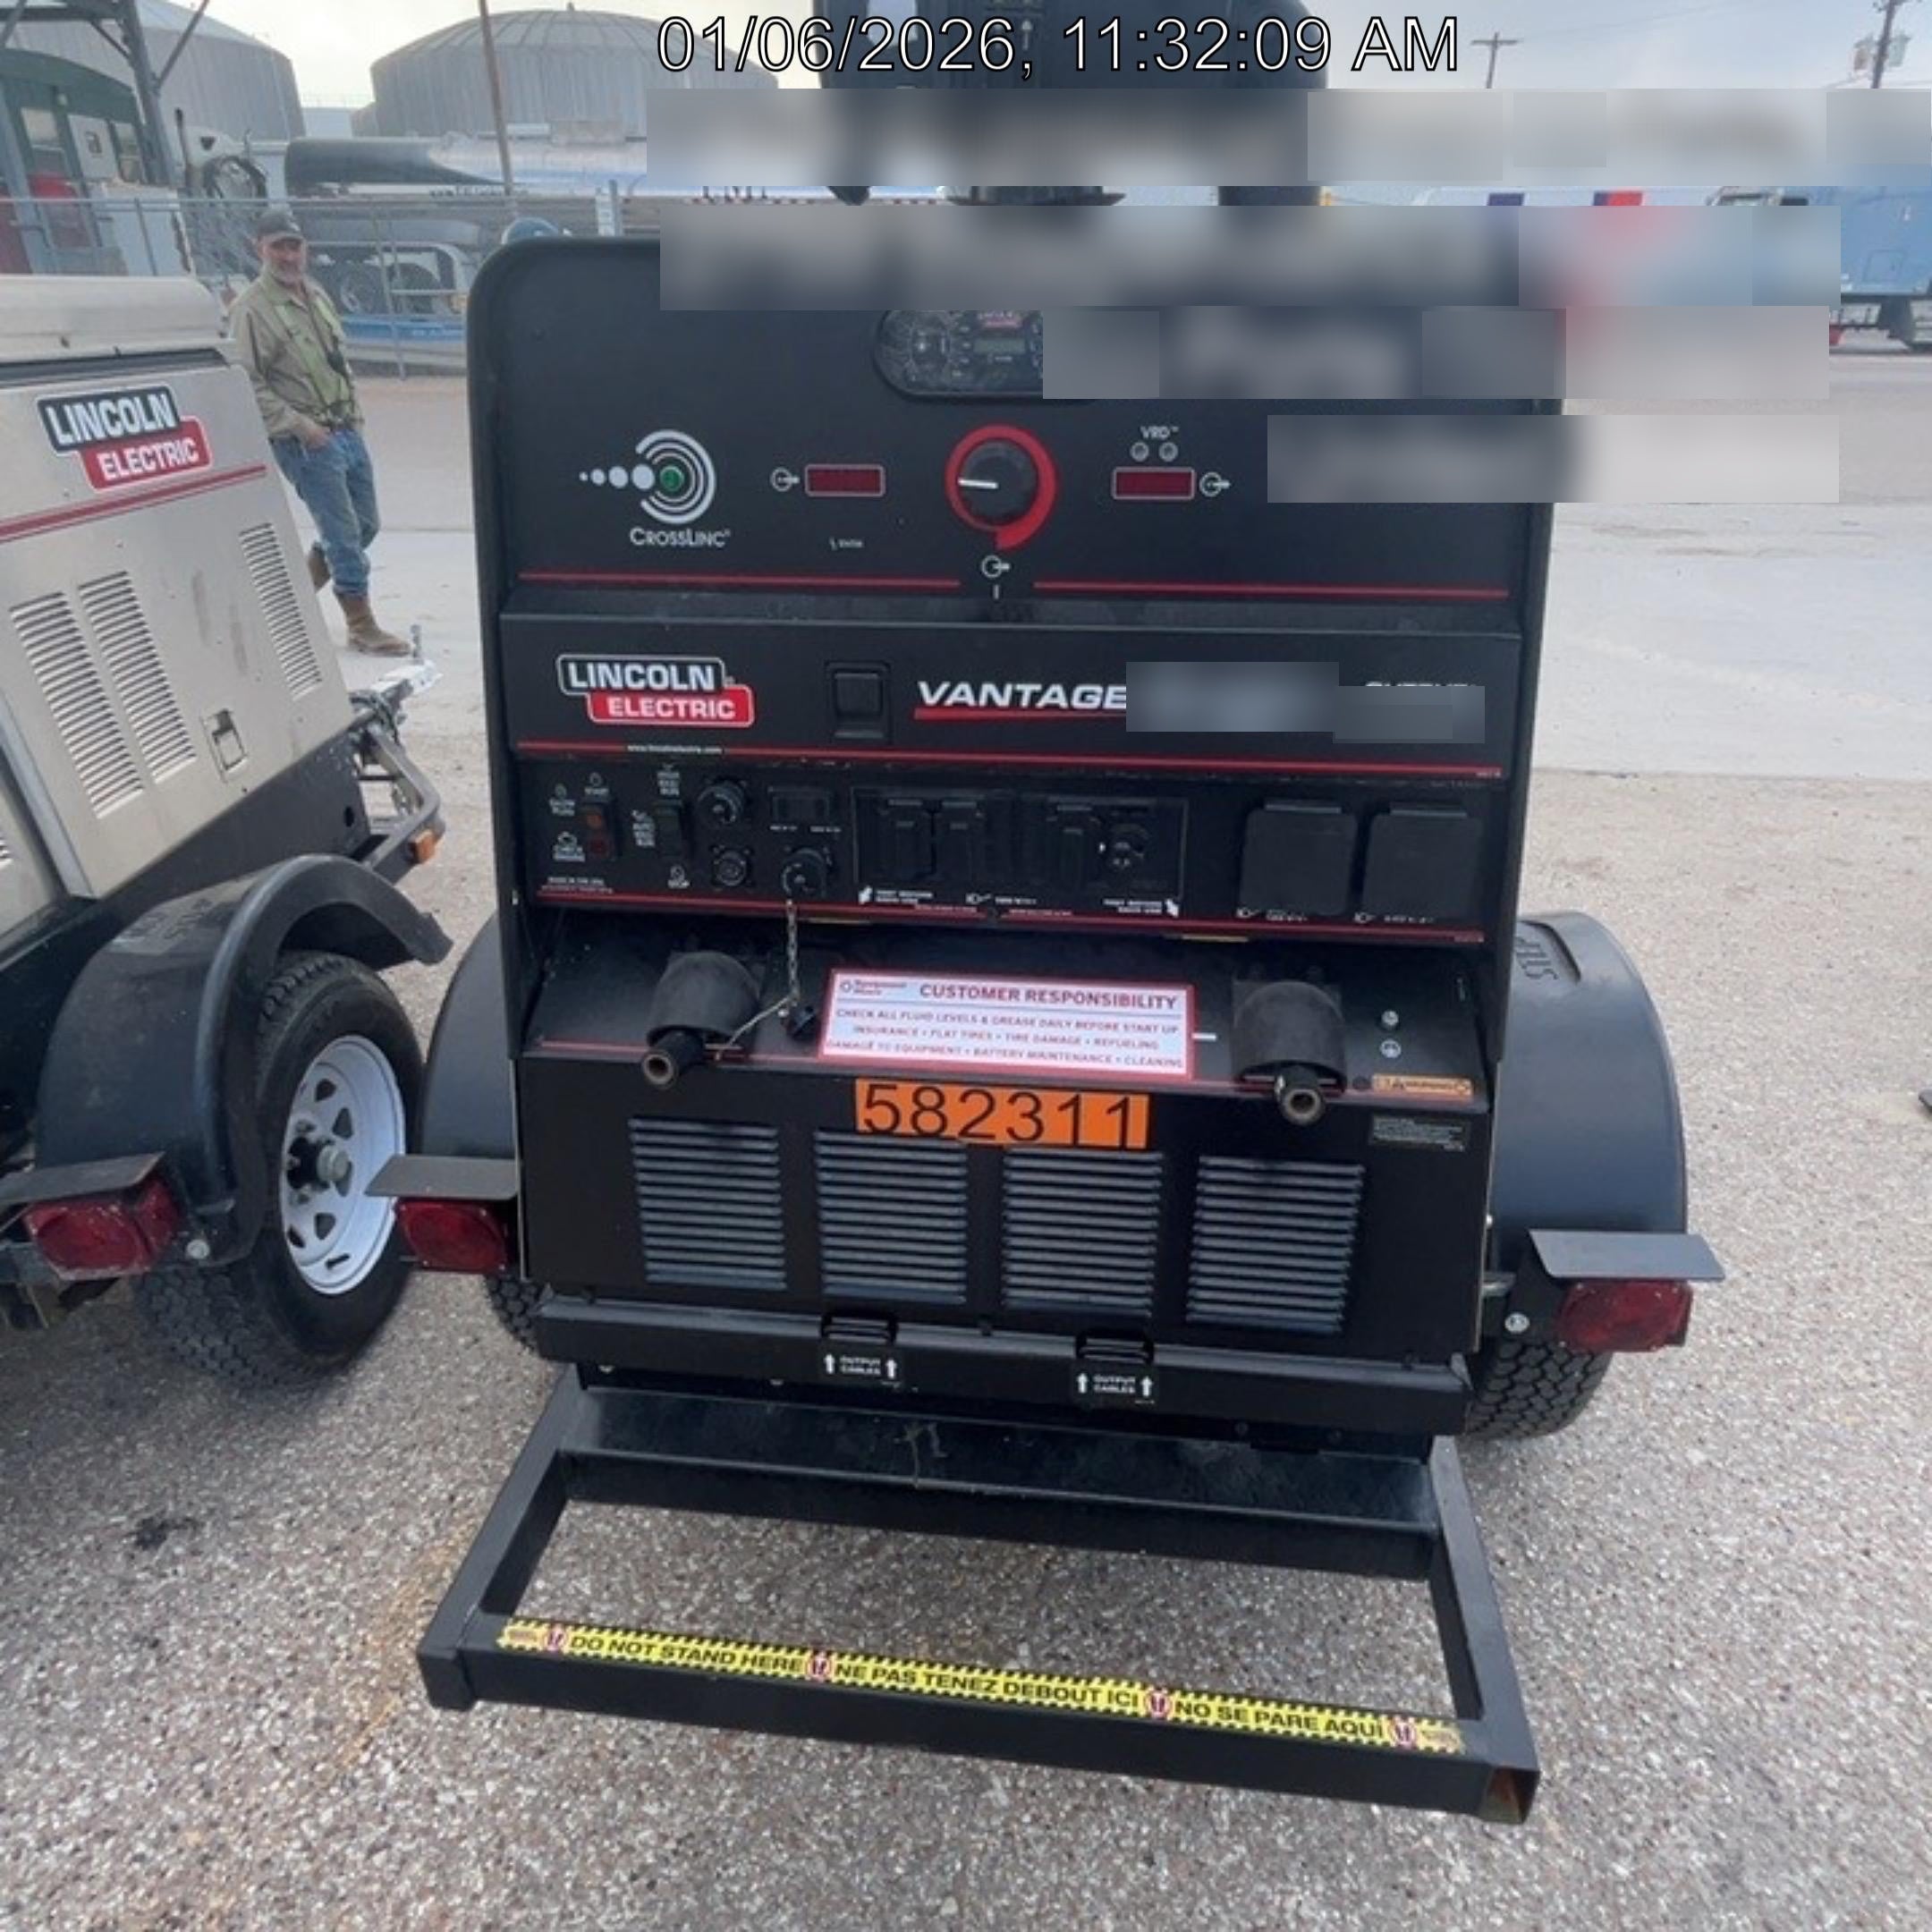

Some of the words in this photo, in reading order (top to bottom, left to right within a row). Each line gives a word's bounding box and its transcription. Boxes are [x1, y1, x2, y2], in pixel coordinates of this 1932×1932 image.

[46, 394, 177, 445] LINCOLN
[97, 437, 199, 481] ELECTRIC
[567, 662, 715, 691] LINCOLN
[606, 696, 736, 719] ELECTRIC
[918, 681, 1126, 710] VANTAGE
[920, 984, 1021, 1002] CUSTOMER
[1025, 989, 1177, 1009] RESPONSIBILITY
[837, 1009, 874, 1019] CHECK
[877, 1011, 897, 1020] ALL
[901, 1012, 934, 1021] FLUID
[936, 1013, 977, 1023] LEVELS
[992, 1016, 1036, 1027] GREASE
[1038, 1018, 1071, 1028] DAILY
[1075, 1021, 1118, 1031] BEFORE
[1123, 1023, 1159, 1033] START
[1163, 1025, 1178, 1034] UP
[854, 1026, 919, 1037] INSURANCE
[931, 1029, 956, 1038] FLAT
[1005, 1033, 1029, 1042] TIRE
[1033, 1035, 1081, 1045] DAMAGE
[1094, 1038, 1159, 1050] REFUELING
[894, 1043, 962, 1055] EQUIPMENT
[973, 1048, 1026, 1058] BATTERY
[1026, 1050, 1112, 1063] MAINTENANCE
[1123, 1055, 1182, 1068] CLEANING
[864, 1083, 1130, 1148] 582311
[571, 1636, 604, 1651] DO
[608, 1640, 657, 1656] NOT
[661, 1645, 736, 1665] STAND
[741, 1655, 803, 1672] HERE
[835, 1663, 867, 1678] NE
[871, 1667, 917, 1683] PAS
[922, 1672, 997, 1693] TENEZ
[1003, 1682, 1100, 1704] DEBOUT
[1107, 1690, 1139, 1707] ICI
[1174, 1699, 1210, 1717] NO
[1217, 1707, 1249, 1723] SE
[1255, 1710, 1318, 1731] PARE
